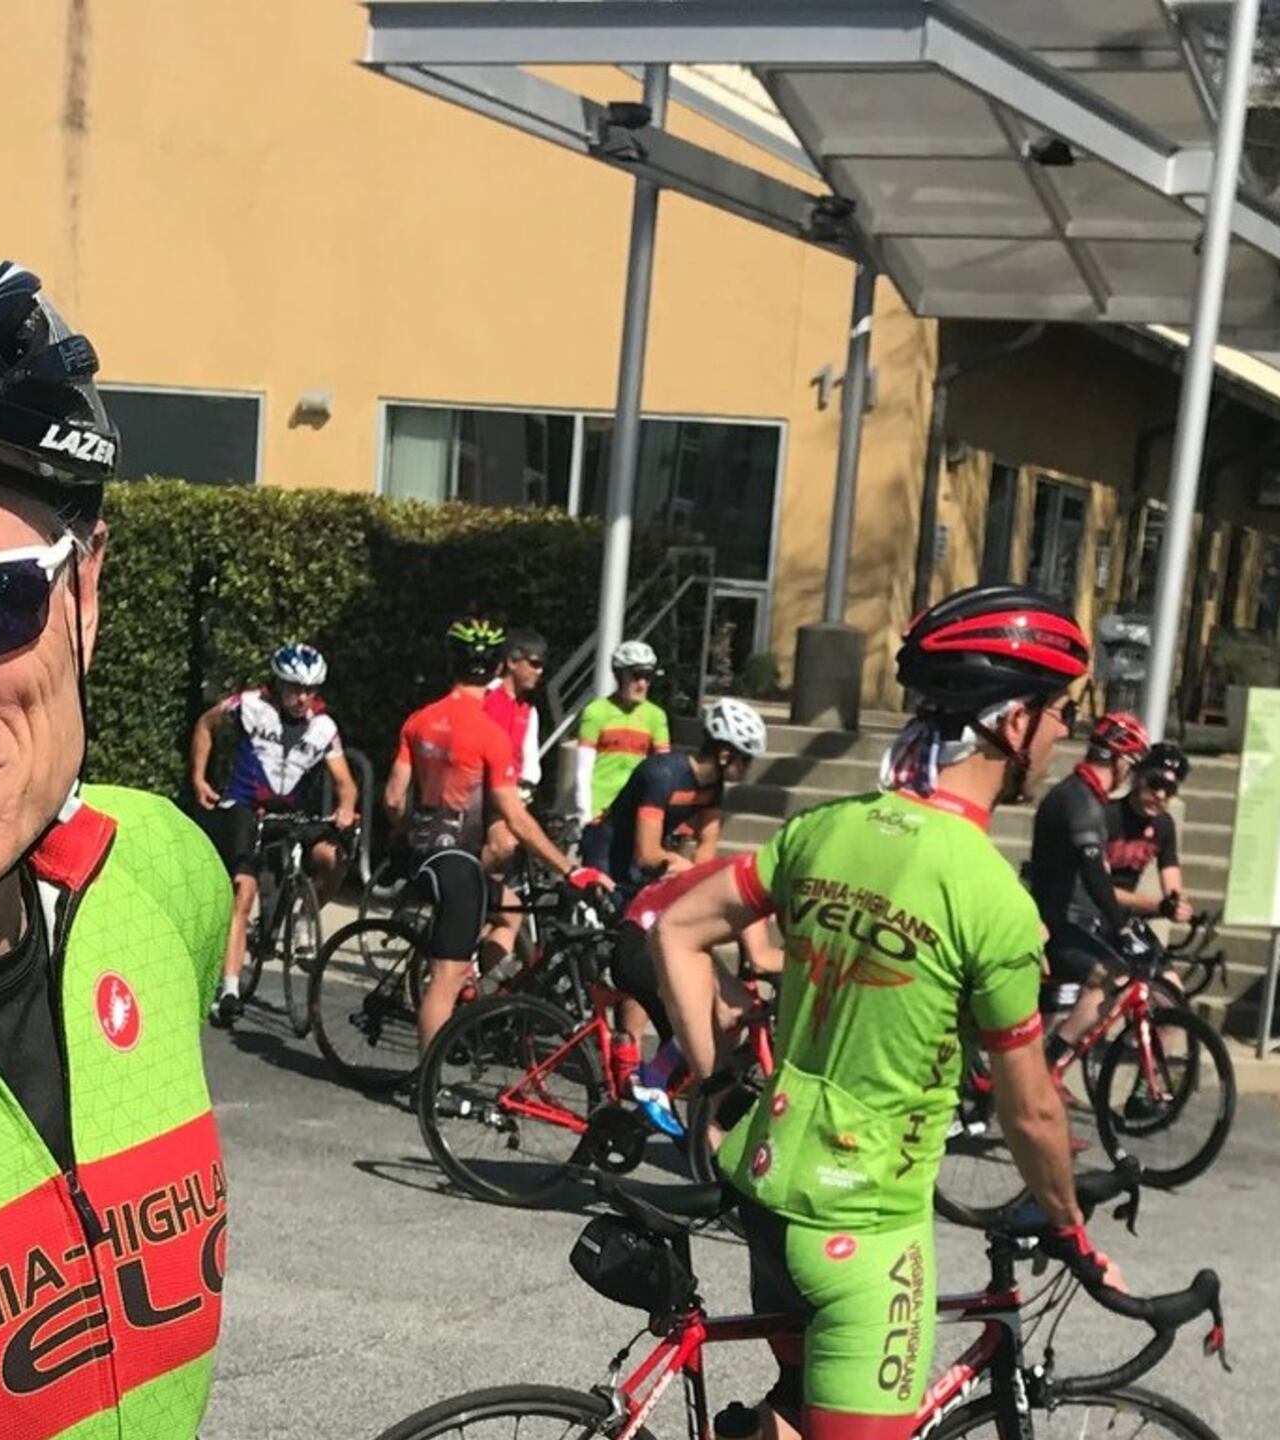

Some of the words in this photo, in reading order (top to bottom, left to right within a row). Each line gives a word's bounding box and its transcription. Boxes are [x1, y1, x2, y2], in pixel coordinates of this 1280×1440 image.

[40, 423, 116, 466] LAZER
[791, 898, 917, 961] VELO
[878, 1253, 912, 1390] VELO
